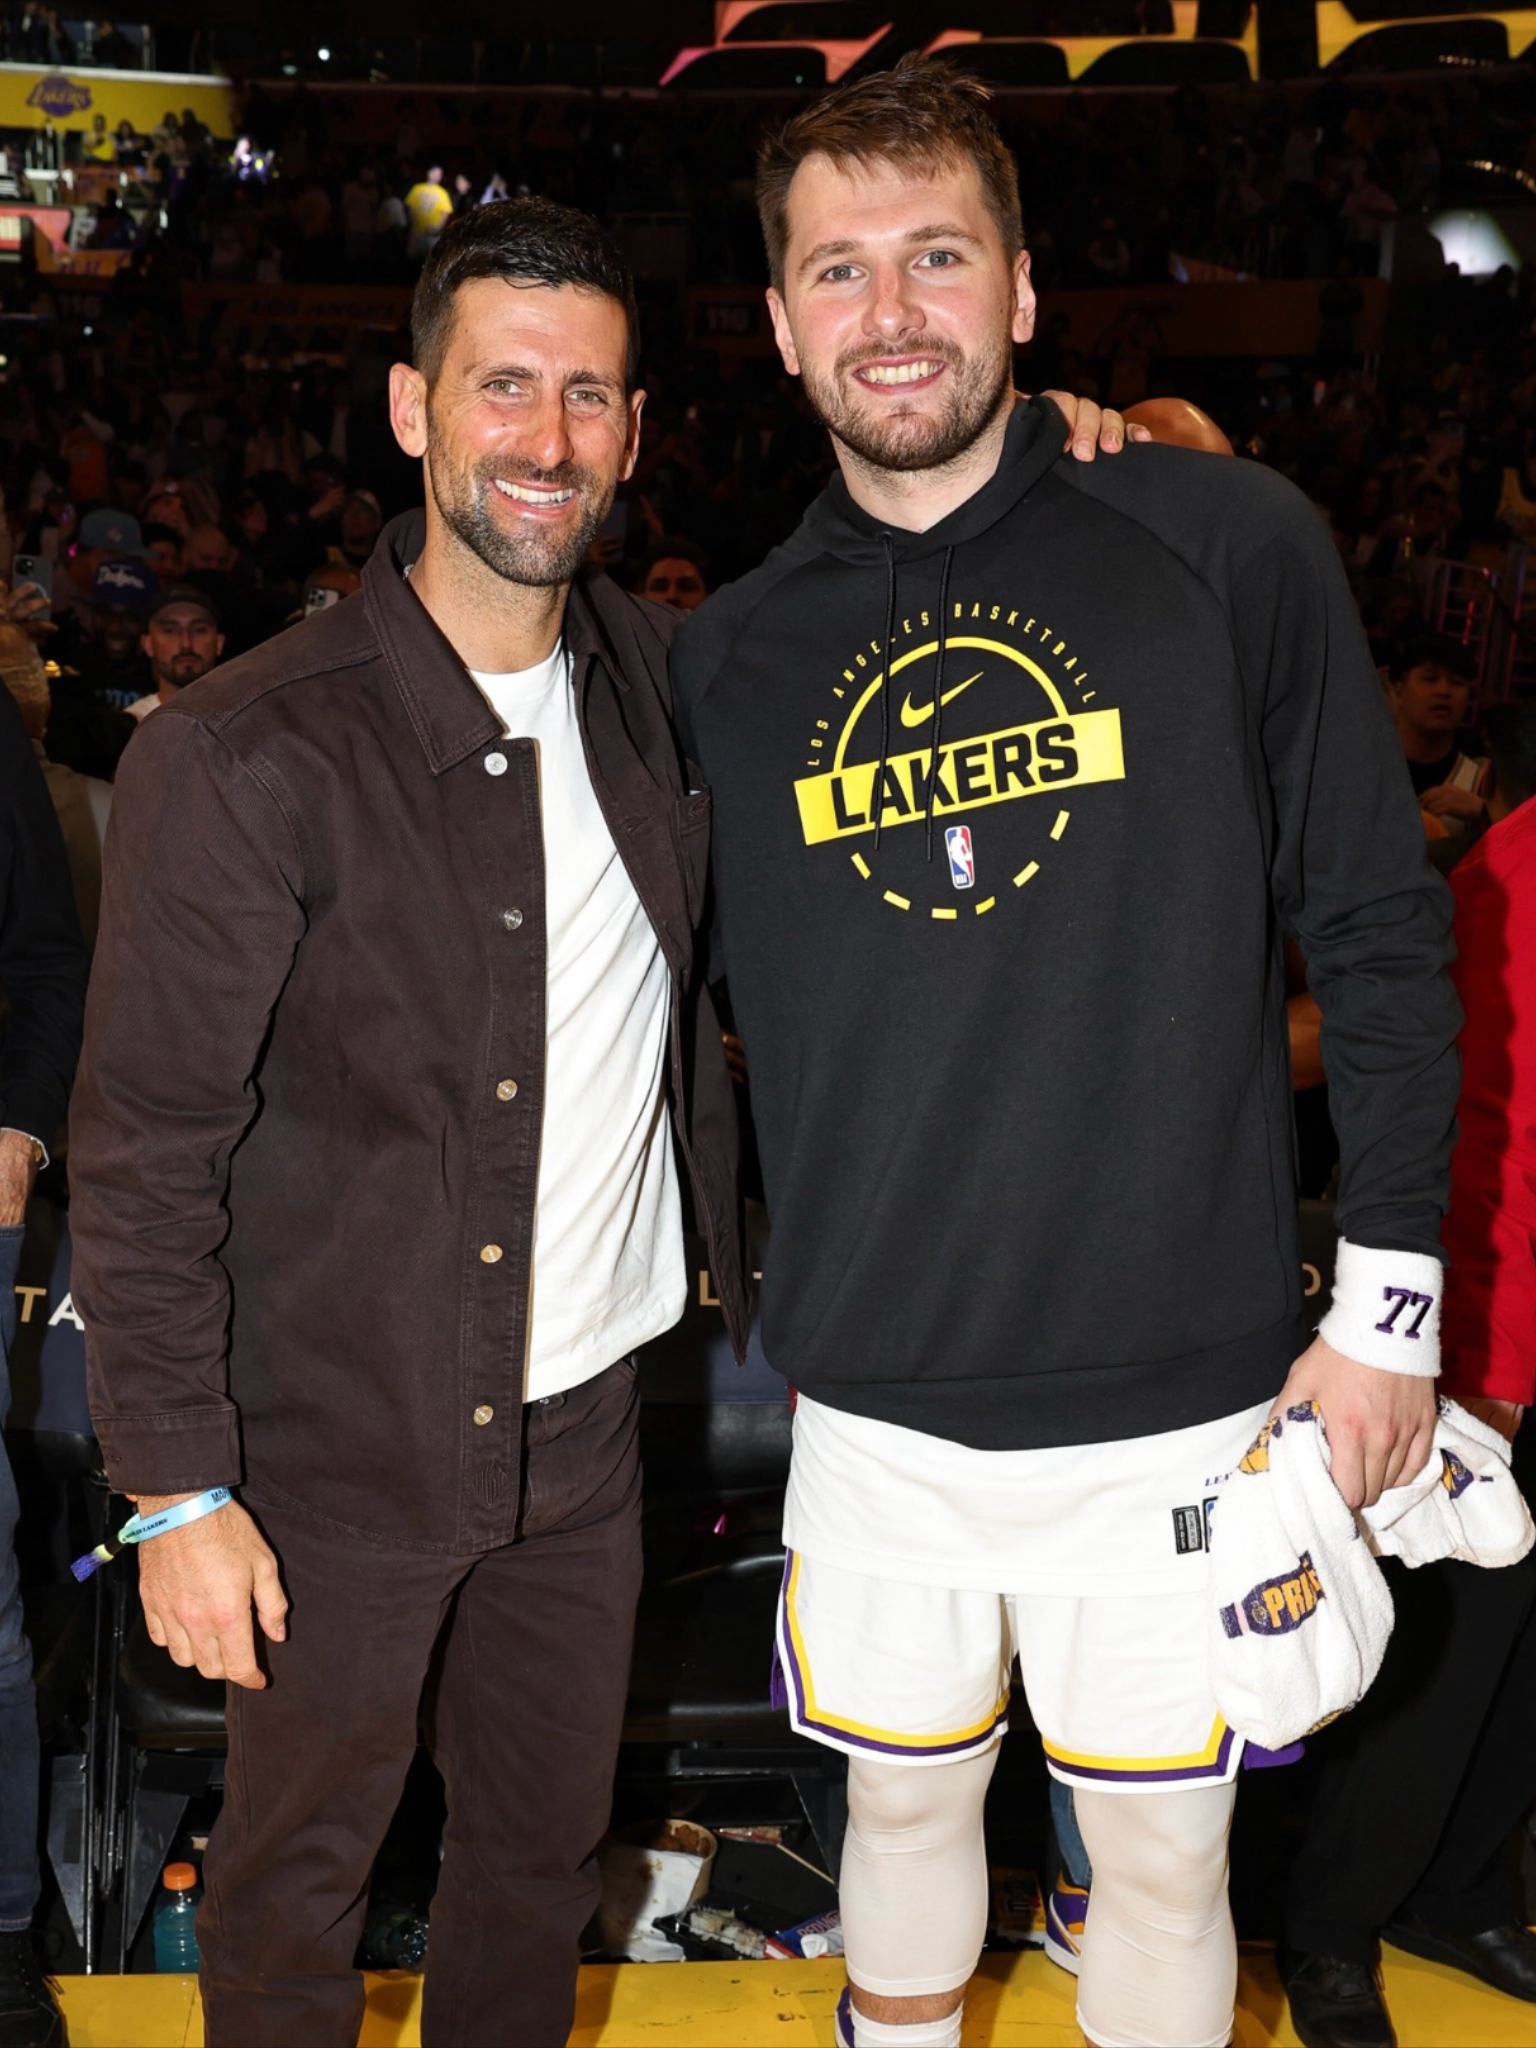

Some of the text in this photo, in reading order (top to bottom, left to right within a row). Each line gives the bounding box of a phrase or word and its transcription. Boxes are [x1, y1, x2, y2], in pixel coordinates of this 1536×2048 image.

[807, 602, 1096, 767] LOS ANGEES BASKETBALL
[830, 723, 1079, 830] LAKERS
[1374, 1285, 1434, 1339] 77
